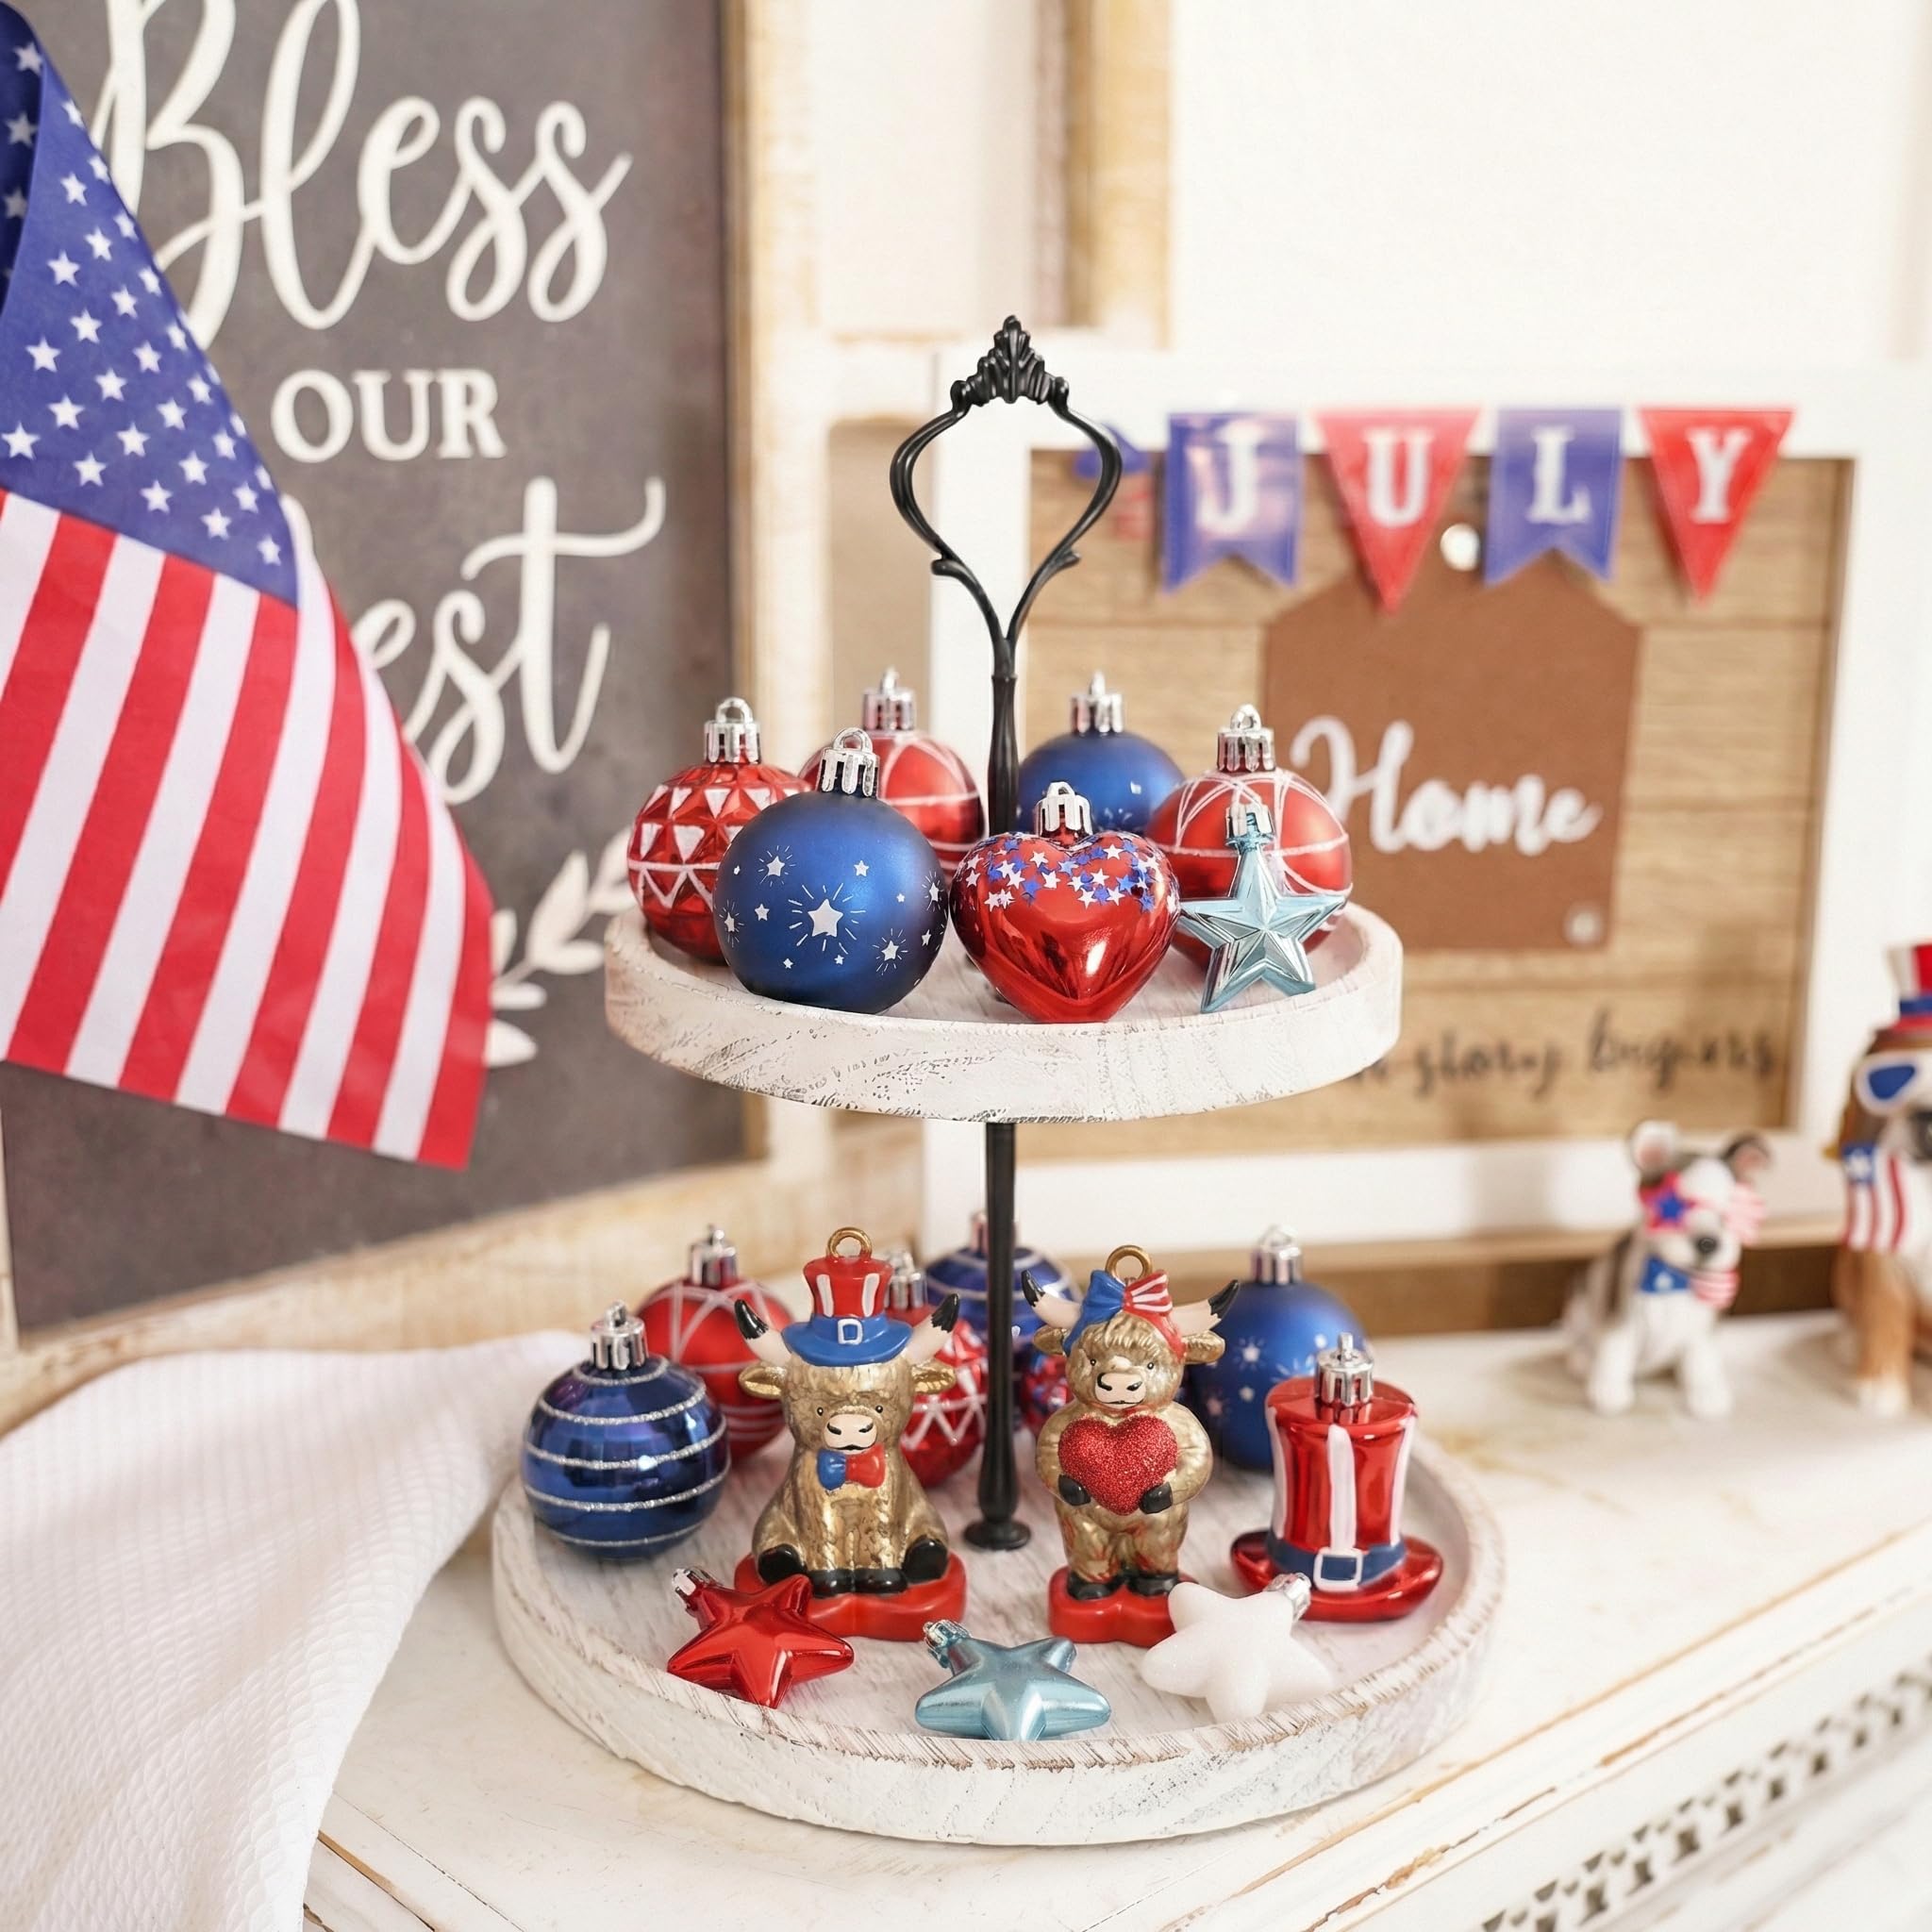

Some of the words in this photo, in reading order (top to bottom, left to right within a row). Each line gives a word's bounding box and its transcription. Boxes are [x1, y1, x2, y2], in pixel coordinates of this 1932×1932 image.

[91, 0, 632, 351] Bless
[271, 370, 506, 462] OUR
[1191, 418, 1750, 535] JULY
[282, 475, 666, 806] est
[1290, 714, 1604, 857] Home
